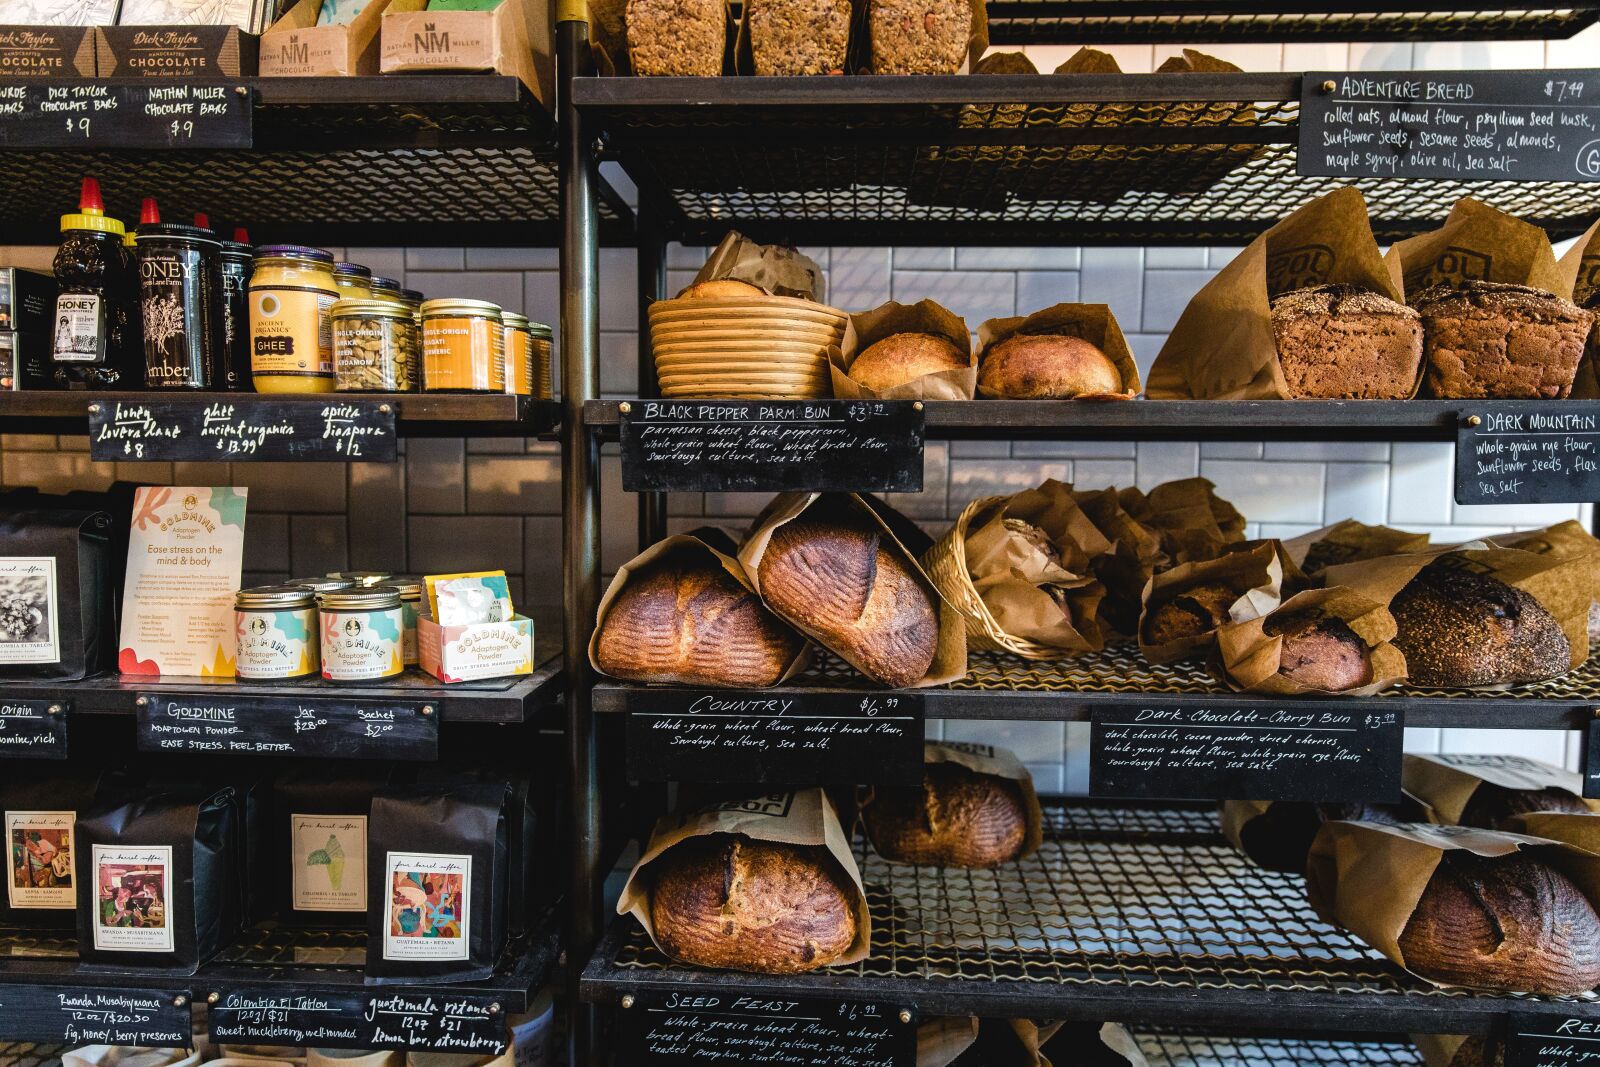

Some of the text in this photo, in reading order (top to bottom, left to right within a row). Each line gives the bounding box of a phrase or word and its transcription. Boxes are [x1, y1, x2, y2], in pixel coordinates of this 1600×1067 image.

[414, 32, 450, 54] NM
[130, 58, 206, 67] CHOCOLATE
[282, 43, 308, 64] NM
[408, 56, 460, 65] CHOCOLATE
[275, 66, 316, 75] CHOCOLATE
[48, 87, 68, 100] DICK
[149, 86, 188, 101] NATHAN
[192, 87, 226, 100] MILLER
[1341, 76, 1474, 100] ADVENTURE BREAD
[1544, 81, 1584, 100] $7.49
[40, 97, 228, 116] CHOCOLATE BARS CHOCOLATE BARS
[1324, 106, 1429, 126] rolled oats, almond
[1506, 131, 1560, 152] almonds,
[1326, 152, 1360, 172] maple
[1410, 152, 1461, 171] olive oil,
[58, 301, 96, 310] HONEY
[258, 341, 286, 351] GHEE
[116, 403, 154, 430] honey
[203, 403, 235, 425] ghee
[321, 402, 360, 423] spices
[644, 404, 832, 420] BLACK PEPPER PARM. BUN
[1486, 412, 1596, 431] DARK MOUNTAIN
[97, 420, 294, 446] lovers lane ancient organics
[640, 424, 851, 440] parmesan cheese, black peppercorn,
[124, 440, 144, 463] $8
[708, 438, 742, 448] wheat
[783, 440, 820, 450] wheat
[1476, 436, 1596, 460] whole-grain rye flour,
[1574, 455, 1597, 472] flax
[160, 512, 216, 534] GOLDMINE
[148, 544, 168, 554] Ease
[170, 546, 194, 554] stress
[209, 544, 223, 554] the
[157, 556, 212, 568] mind & body
[458, 630, 521, 653] GOLDMINE
[472, 644, 508, 654] Adaptogen
[338, 652, 372, 660] Adaptogen
[478, 652, 502, 661] Powder
[2, 704, 33, 717] Origin
[168, 702, 236, 720] GOLDMINE
[689, 696, 793, 716] COUNTRY
[1135, 708, 1184, 722] Dark
[296, 718, 394, 738] $28.00 $2.00
[725, 720, 760, 731] wheat
[804, 722, 839, 733] wheat
[840, 724, 873, 734] bread
[876, 723, 903, 736] flour,
[1323, 714, 1352, 728] Bun
[34, 732, 55, 744] rich
[161, 740, 183, 750] EASE
[230, 740, 255, 752] FEEL
[724, 735, 770, 750] culture,
[1105, 728, 1130, 739] dark
[1132, 729, 1179, 742] chocolate,
[1212, 733, 1254, 744] powder,
[1260, 734, 1292, 744] dried
[1296, 734, 1341, 750] cherries,
[1104, 742, 1165, 757] whole-grain
[1170, 745, 1206, 756] wheat
[1242, 748, 1306, 762] whole-grain
[1312, 752, 1331, 762] rye
[1107, 757, 1278, 771] sourdough culture, sea salt.
[295, 996, 328, 1010] Tablon
[365, 996, 438, 1022] guatemala
[666, 993, 800, 1012] SEED FEAST
[216, 1024, 304, 1042] sweet, huckleberry,
[440, 1017, 461, 1032] $21
[753, 1022, 839, 1038] wheat flour,
[83, 1028, 114, 1044] honey,
[116, 1030, 138, 1047] berry
[140, 1032, 183, 1042] preserves
[372, 1027, 405, 1043] lemon
[435, 1032, 504, 1055] strawberry
[646, 1028, 684, 1042] bread
[724, 1035, 777, 1051] sourdough
[780, 1038, 823, 1052] culture,
[827, 1044, 845, 1052] sea
[650, 1042, 745, 1061] toasted pumpkin,
